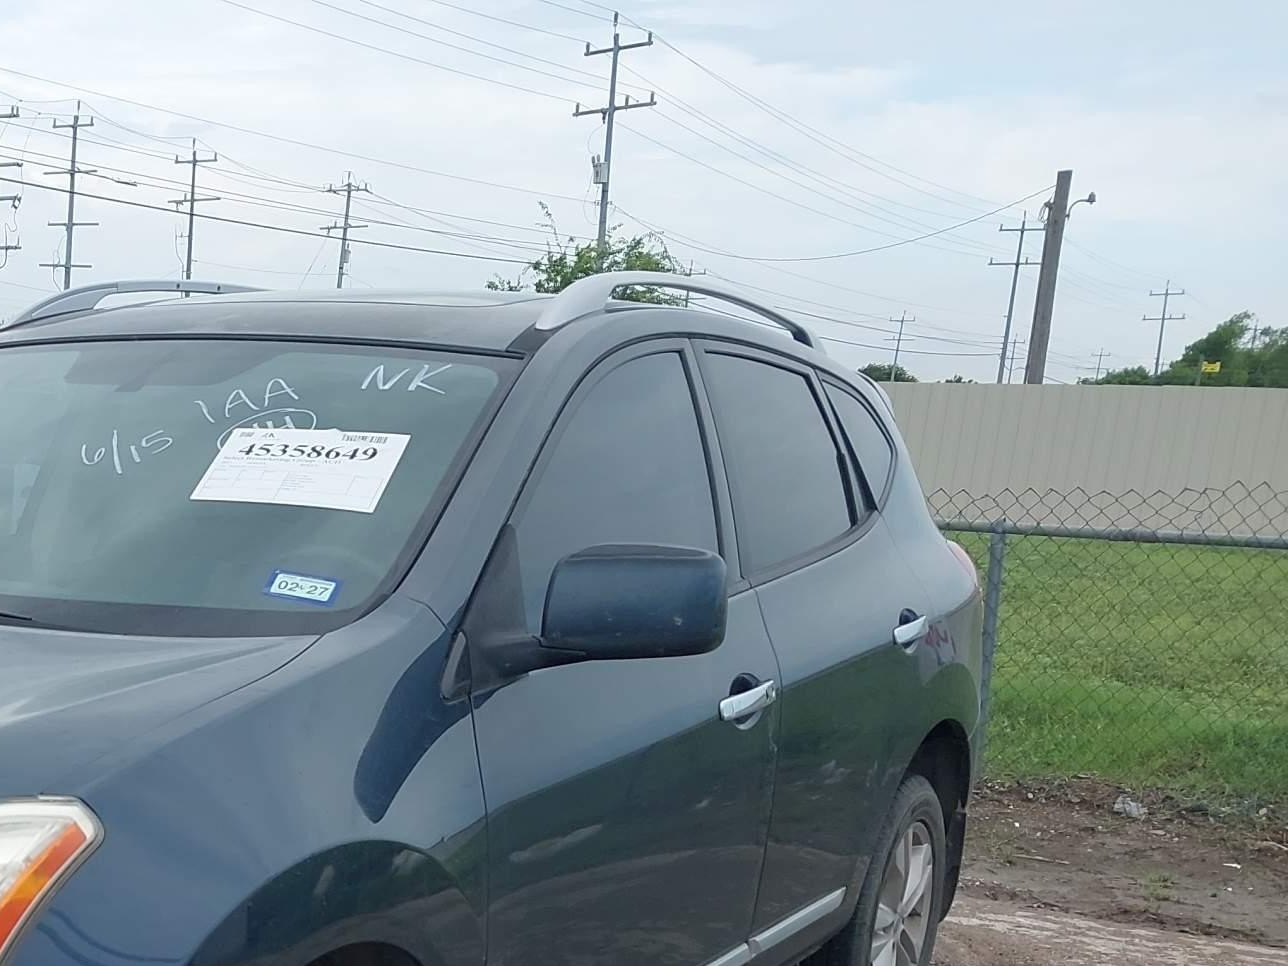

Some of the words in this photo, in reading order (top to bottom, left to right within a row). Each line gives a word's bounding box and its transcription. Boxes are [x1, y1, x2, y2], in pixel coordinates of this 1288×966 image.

[361, 363, 453, 396] NK
[80, 429, 174, 475] 6/15
[238, 442, 379, 462] 45358649
[277, 580, 300, 592] 02
[306, 584, 330, 597] 27
